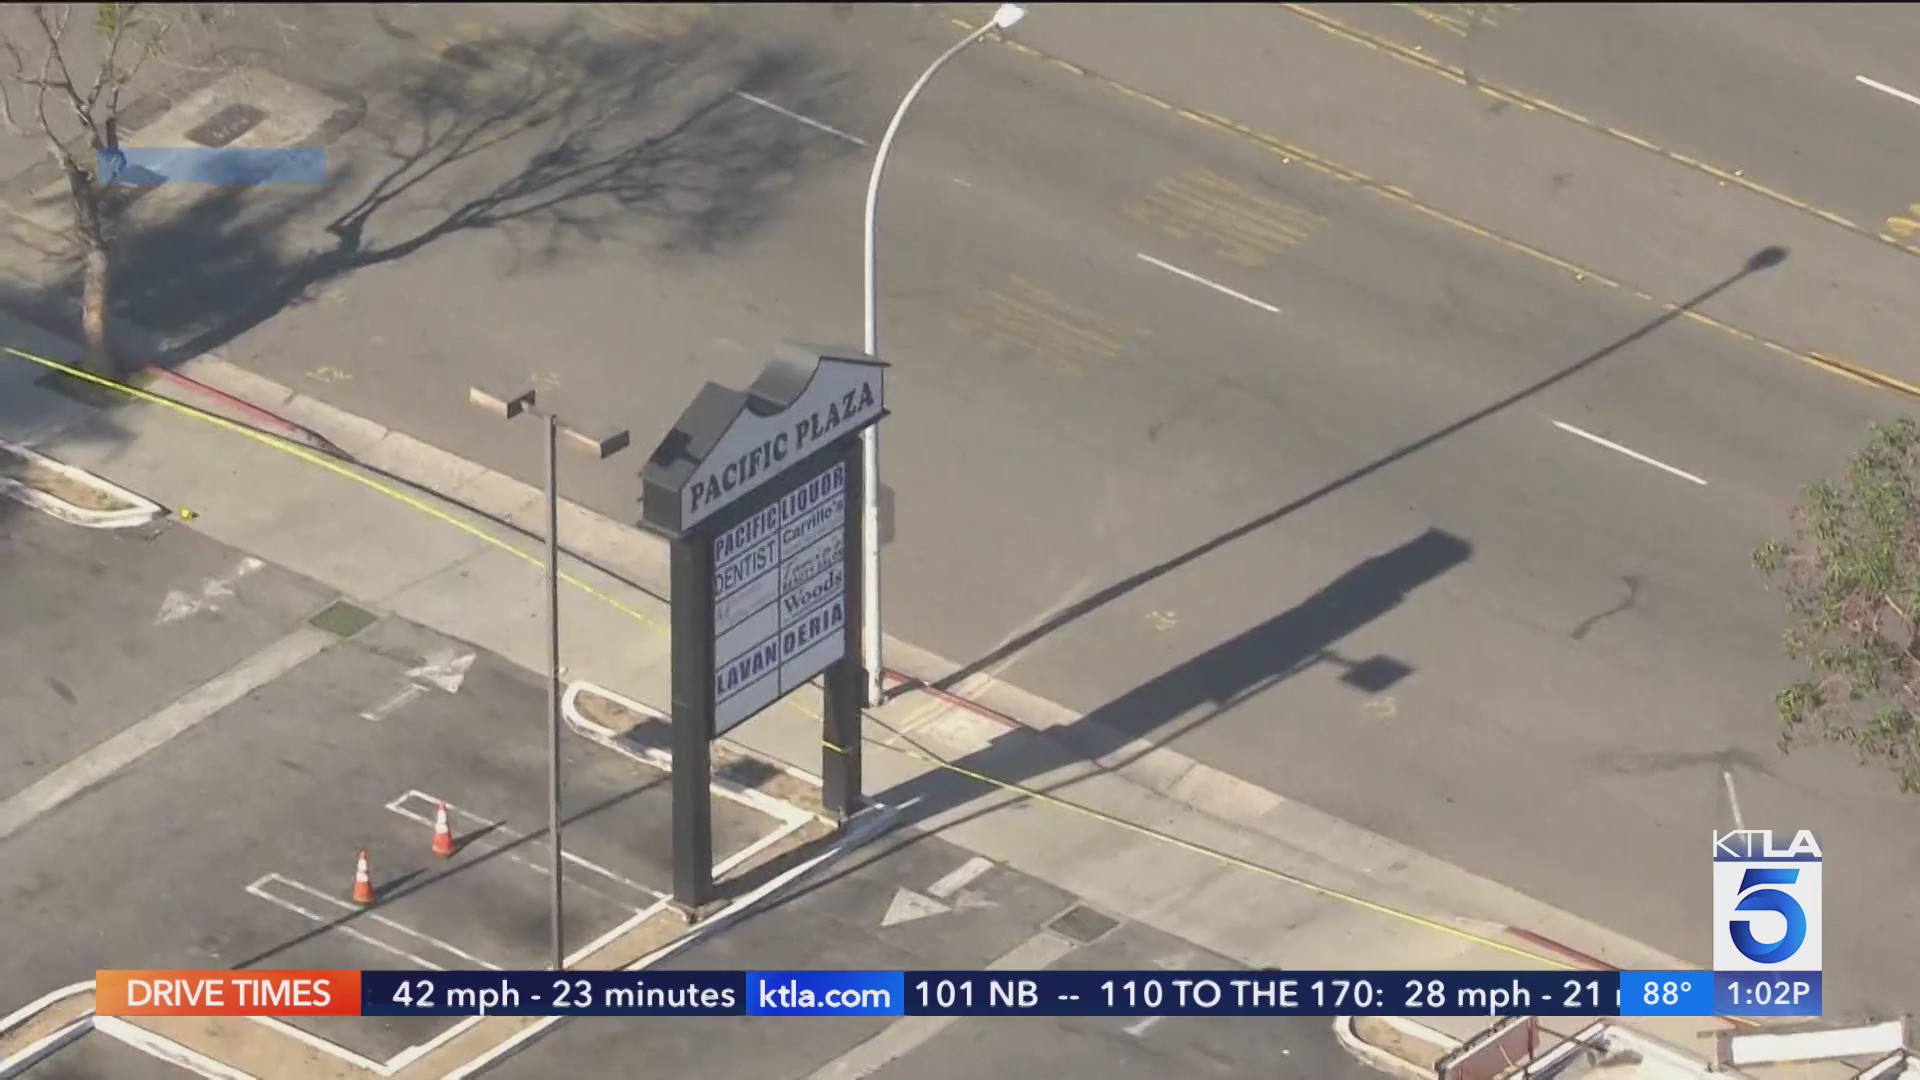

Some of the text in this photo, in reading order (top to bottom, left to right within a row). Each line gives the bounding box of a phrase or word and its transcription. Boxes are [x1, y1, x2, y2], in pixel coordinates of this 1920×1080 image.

[690, 382, 874, 513] PACIFIC PLAZA
[716, 466, 844, 561] PACIFIC LIQUOR
[715, 540, 776, 593] DENTIST
[783, 570, 843, 613] Woods
[717, 603, 842, 695] LAVAN DERIA
